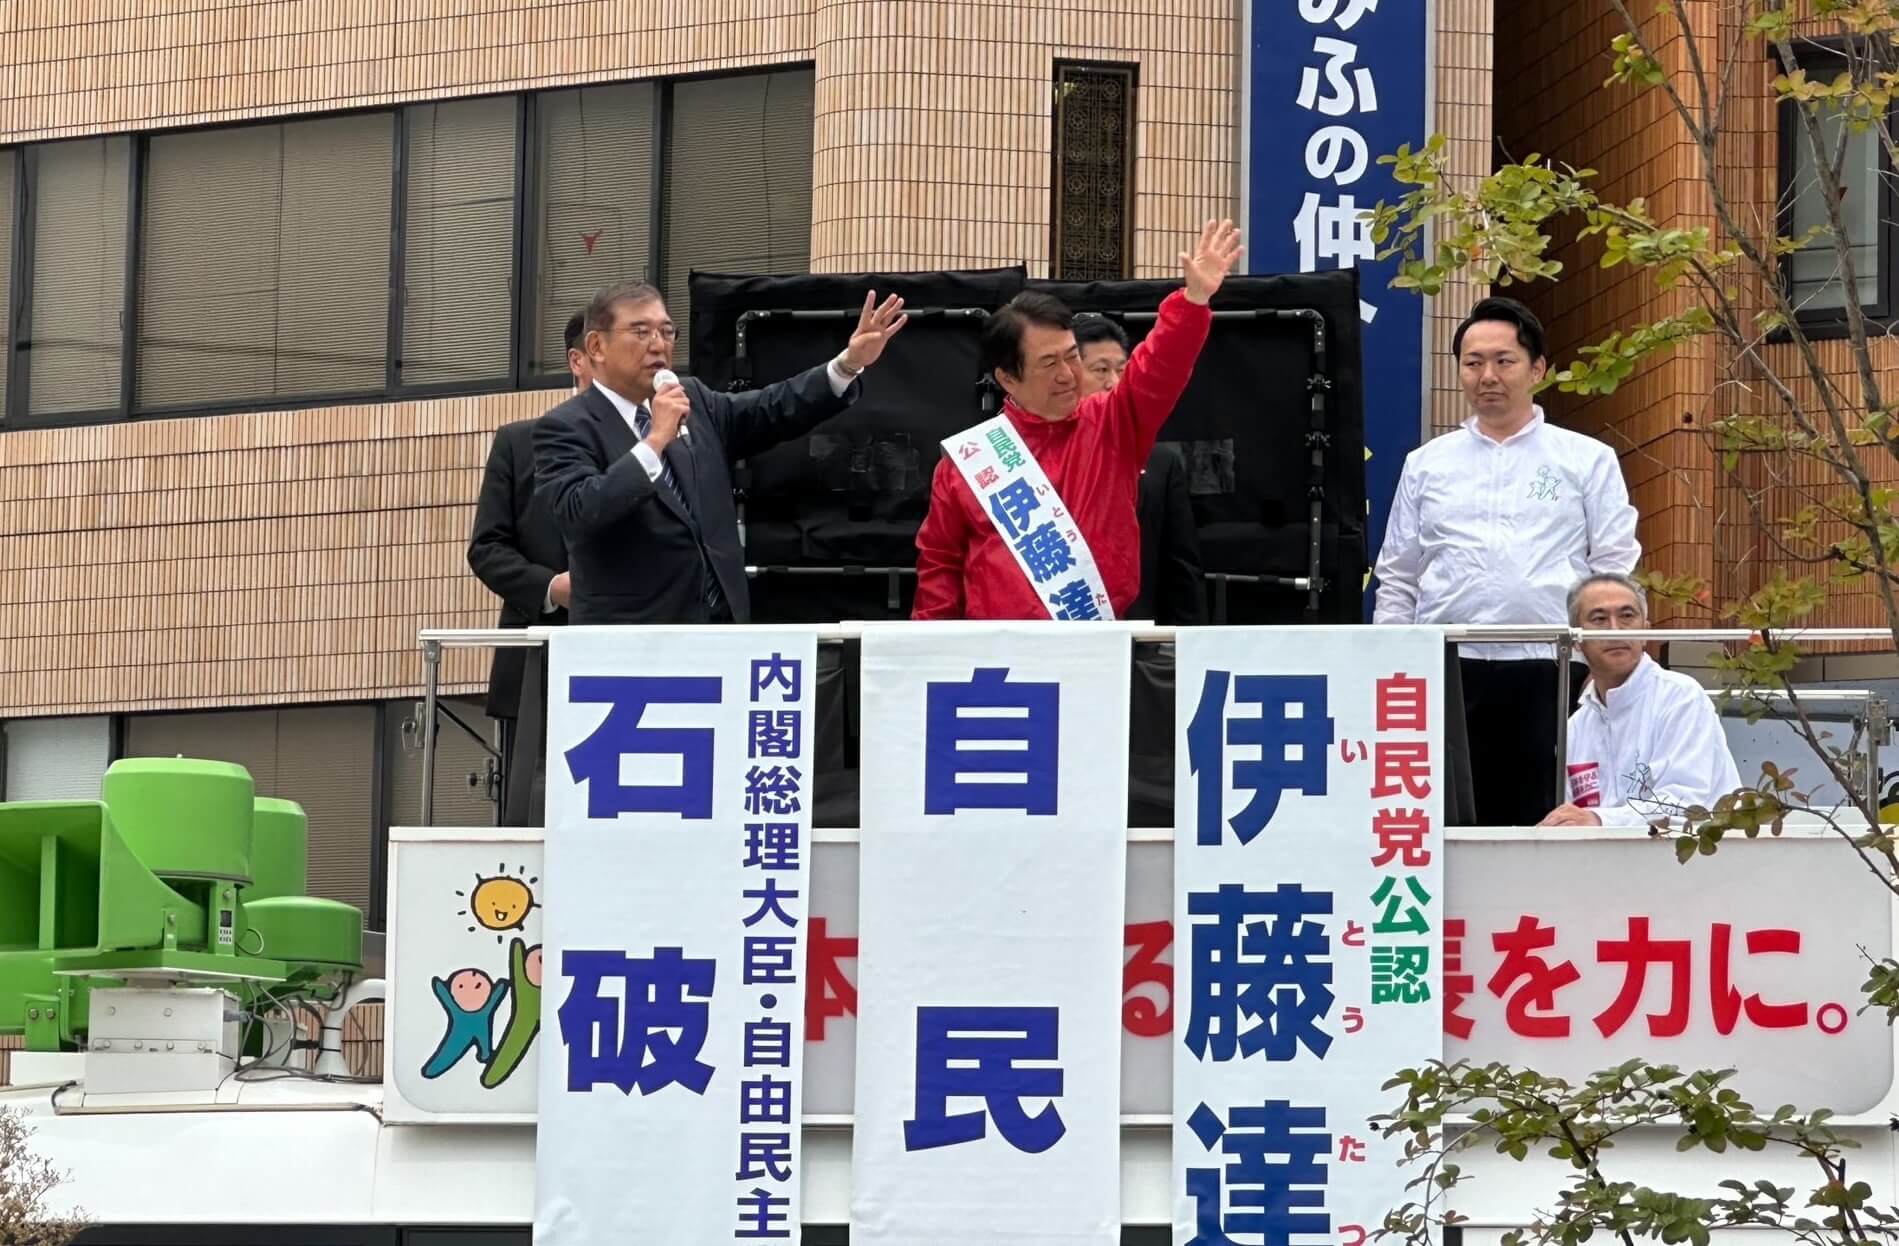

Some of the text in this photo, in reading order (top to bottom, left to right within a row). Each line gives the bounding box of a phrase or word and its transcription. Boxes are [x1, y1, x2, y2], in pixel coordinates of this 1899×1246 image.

[1293, 0, 1378, 324] ふの仲
[959, 441, 1000, 490] 公認
[986, 427, 1026, 472] 自民党
[558, 675, 723, 1097] 石破
[735, 652, 801, 1238] 内閣総理大臣・自由民主
[903, 667, 1067, 1154] 自民
[1184, 669, 1335, 1246] 伊藤達
[1370, 672, 1431, 1005] 自民党公認
